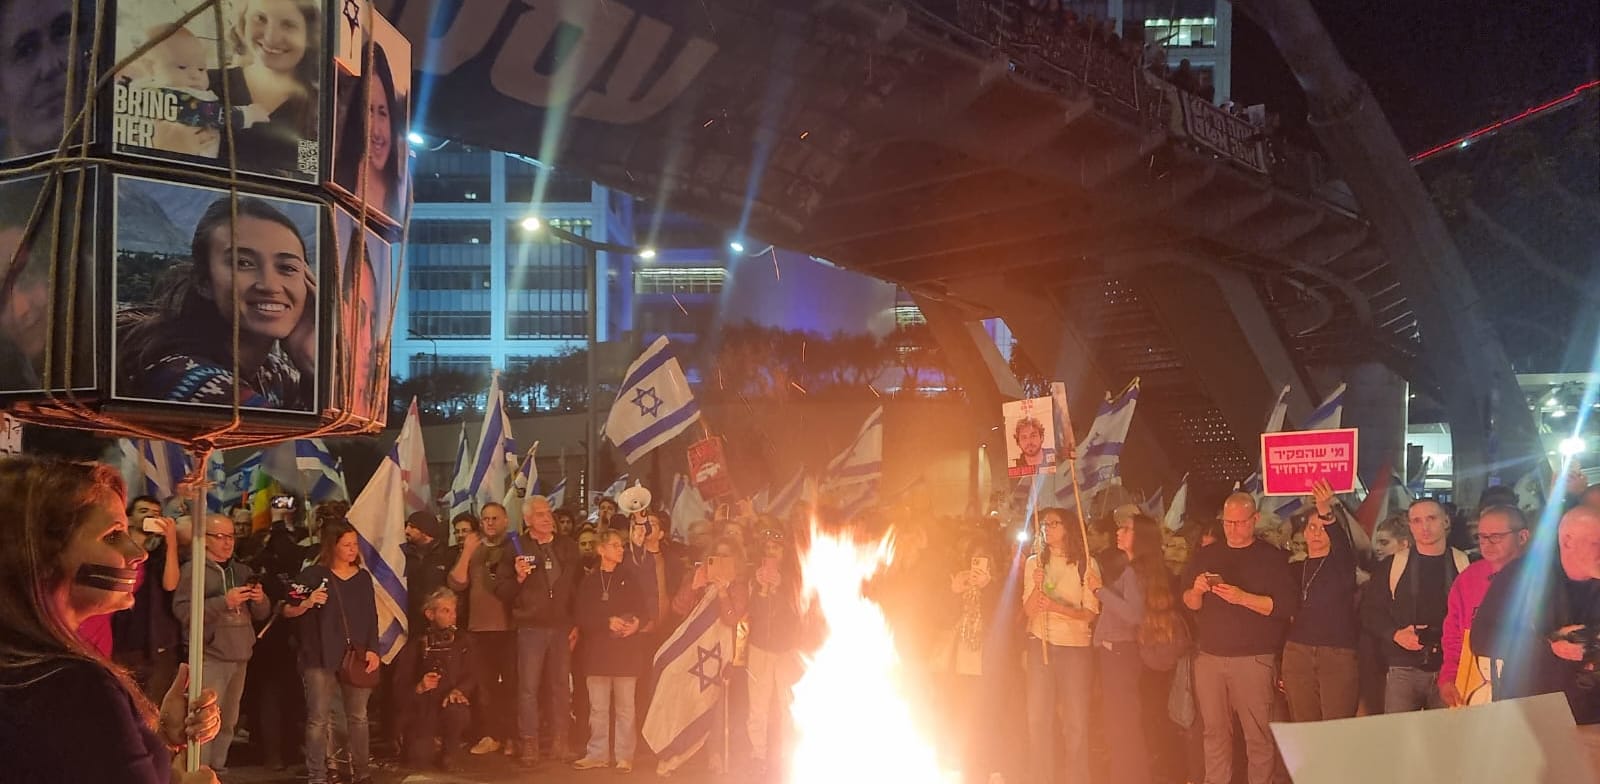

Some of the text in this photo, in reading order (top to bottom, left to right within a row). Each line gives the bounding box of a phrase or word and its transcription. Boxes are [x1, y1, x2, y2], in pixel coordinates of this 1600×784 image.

[114, 83, 178, 122] BRING
[112, 114, 154, 149] HER
[1274, 447, 1344, 460] מי שהפקיר
[1270, 462, 1348, 475] חייב להחזיר
